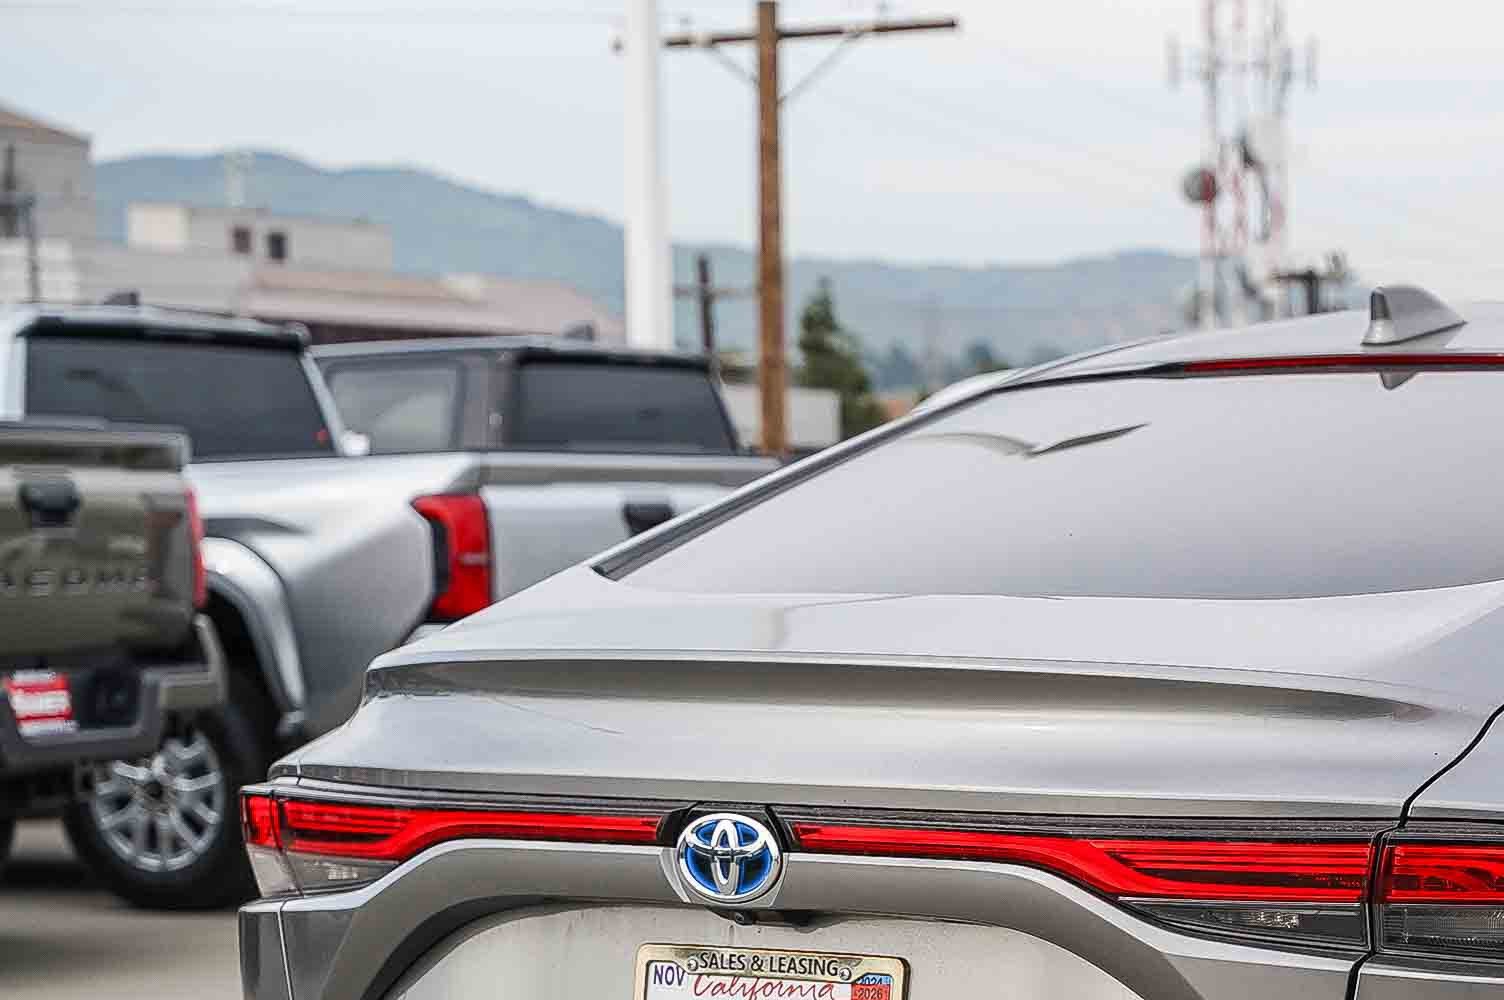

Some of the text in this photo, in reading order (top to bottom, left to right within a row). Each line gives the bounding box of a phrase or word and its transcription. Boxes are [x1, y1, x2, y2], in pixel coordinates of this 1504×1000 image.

[653, 964, 686, 987] NOV
[701, 952, 838, 977] SALES & LEASING
[857, 987, 883, 1000] 2026
